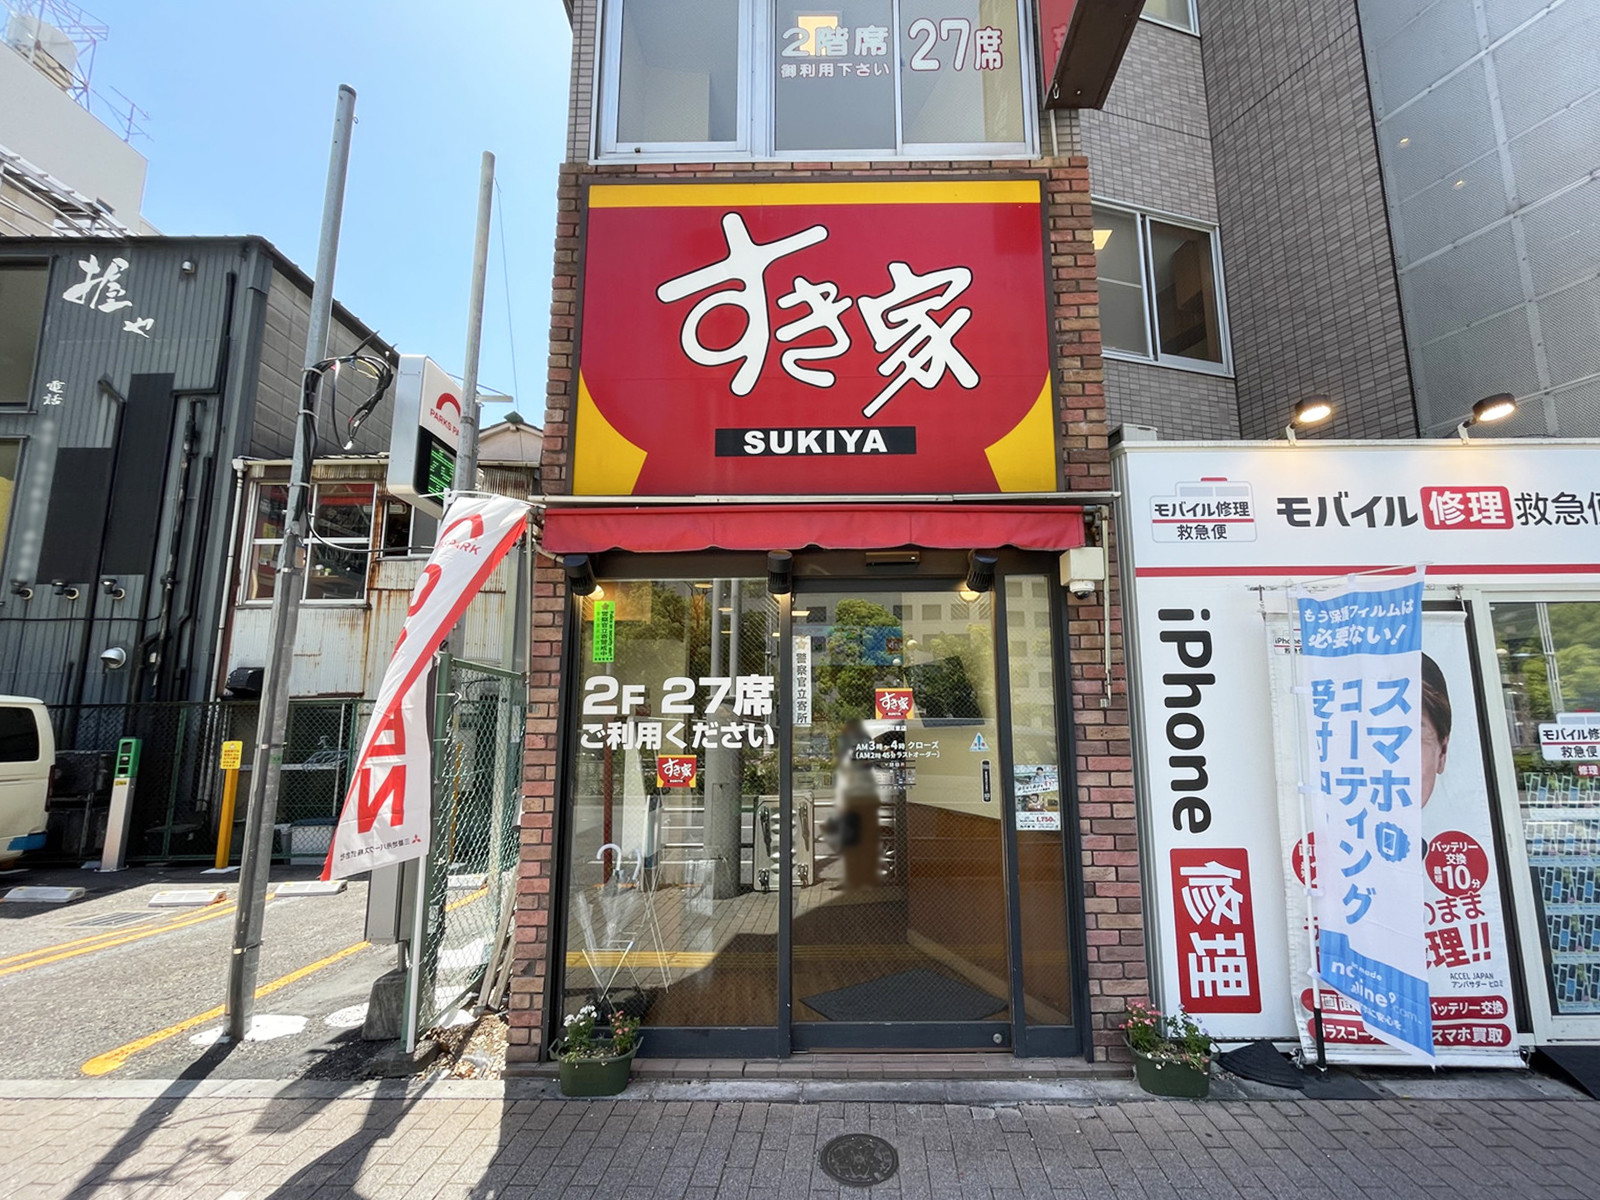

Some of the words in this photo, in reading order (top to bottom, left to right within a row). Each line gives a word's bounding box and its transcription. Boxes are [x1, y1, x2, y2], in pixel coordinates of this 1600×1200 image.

[781, 24, 889, 57] 2階席
[909, 18, 1003, 71] 27席
[781, 62, 890, 78] 御利用下さい
[656, 211, 981, 419] すき家
[430, 408, 452, 431] PARKS
[743, 428, 888, 455] SUKIYA
[1154, 500, 1251, 517] モバイル修理
[1176, 524, 1228, 540] 救急便
[583, 676, 645, 715] 2F
[661, 674, 775, 717] 27席
[796, 652, 808, 724] 警察官立寄所
[879, 691, 909, 712] すき家
[1157, 608, 1216, 834] iPhone
[581, 721, 775, 751] ご利用ください
[1366, 677, 1413, 812] スマホ
[662, 757, 692, 780] すき家
[1334, 677, 1377, 926] コーティング
[1431, 841, 1479, 854] バッテリー
[1445, 853, 1467, 865] 交換
[1179, 860, 1251, 1000] 修理
[1450, 972, 1471, 980] ACCEL
[1472, 972, 1494, 980] JAPAN
